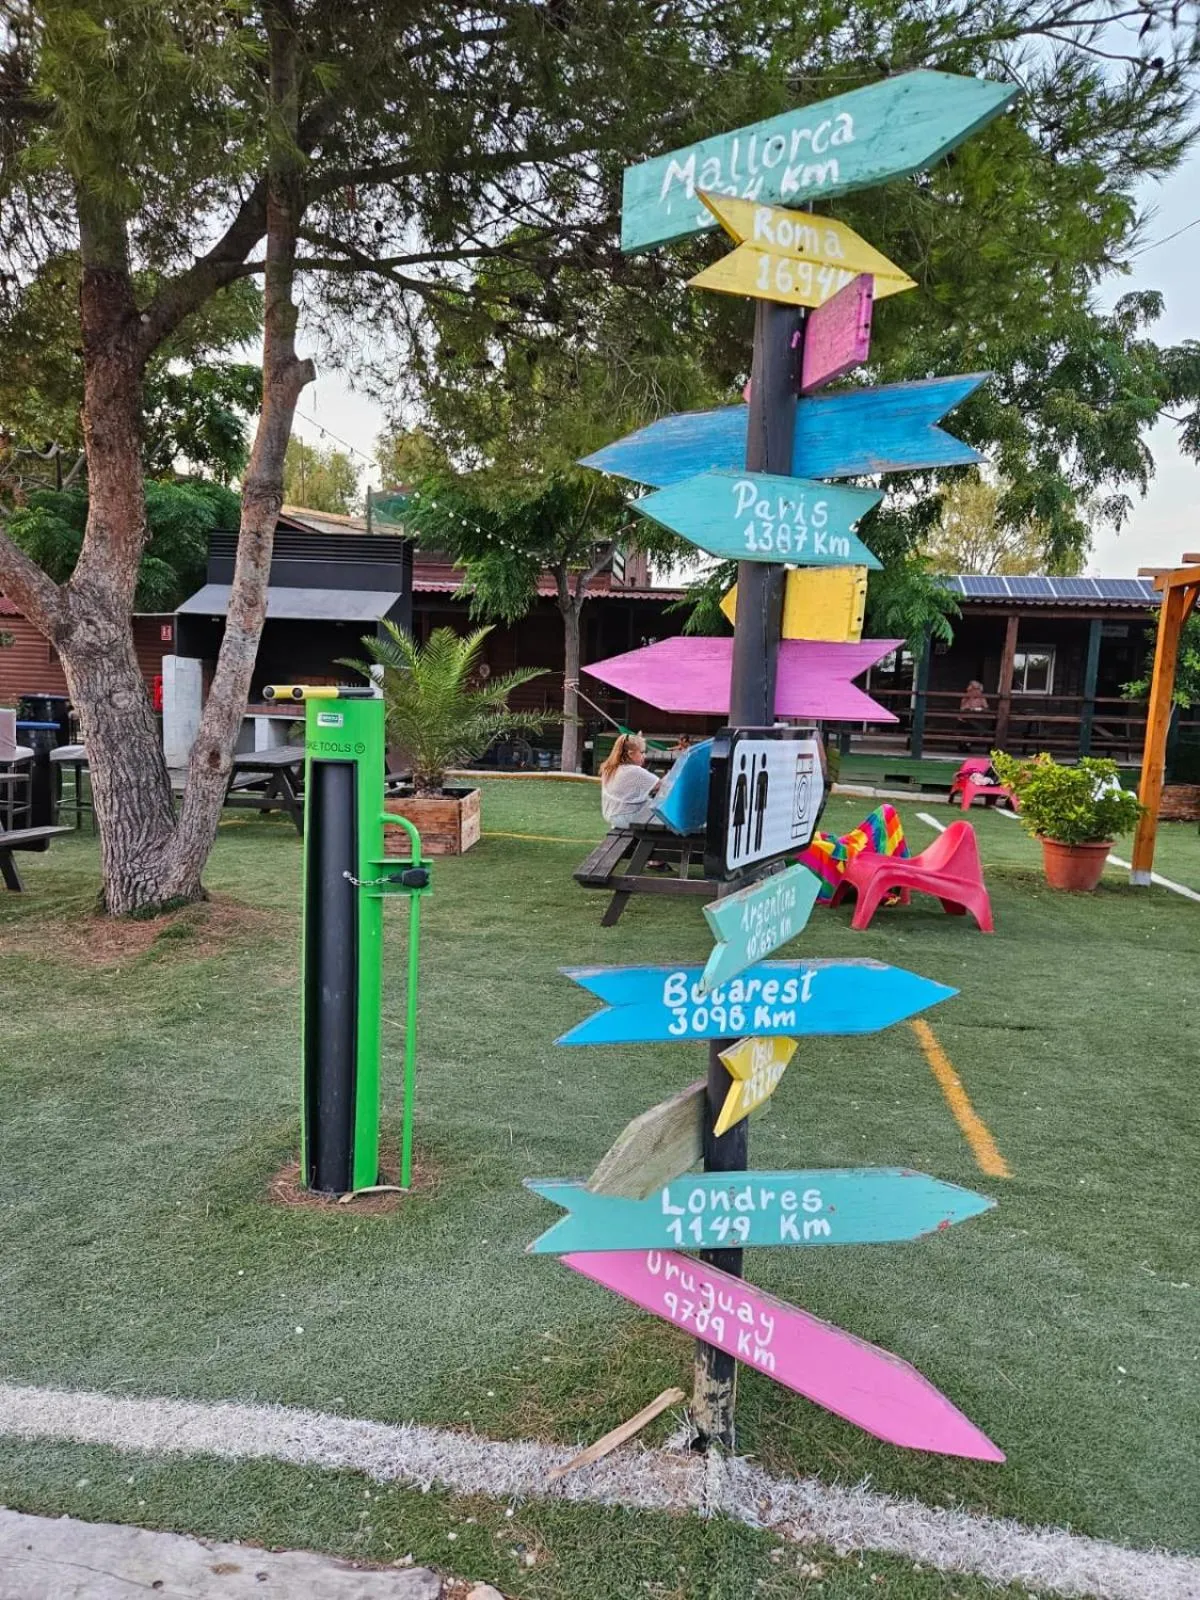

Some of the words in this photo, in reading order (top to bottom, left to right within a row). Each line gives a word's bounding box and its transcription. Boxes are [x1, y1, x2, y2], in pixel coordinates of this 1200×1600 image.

[660, 113, 855, 204] Mallorca
[780, 158, 839, 199] Km
[754, 207, 845, 259] Roma
[757, 254, 834, 304] 1694
[732, 480, 828, 528] Paris
[744, 521, 808, 554] 1387
[814, 530, 850, 558] Km
[663, 970, 818, 1008] Bucarest
[754, 1005, 796, 1029] Km
[662, 1186, 823, 1215] Londres
[666, 1216, 750, 1245] 1149
[780, 1213, 832, 1242] Km
[647, 1250, 775, 1347] Uruguay
[737, 1329, 776, 1371] Km
